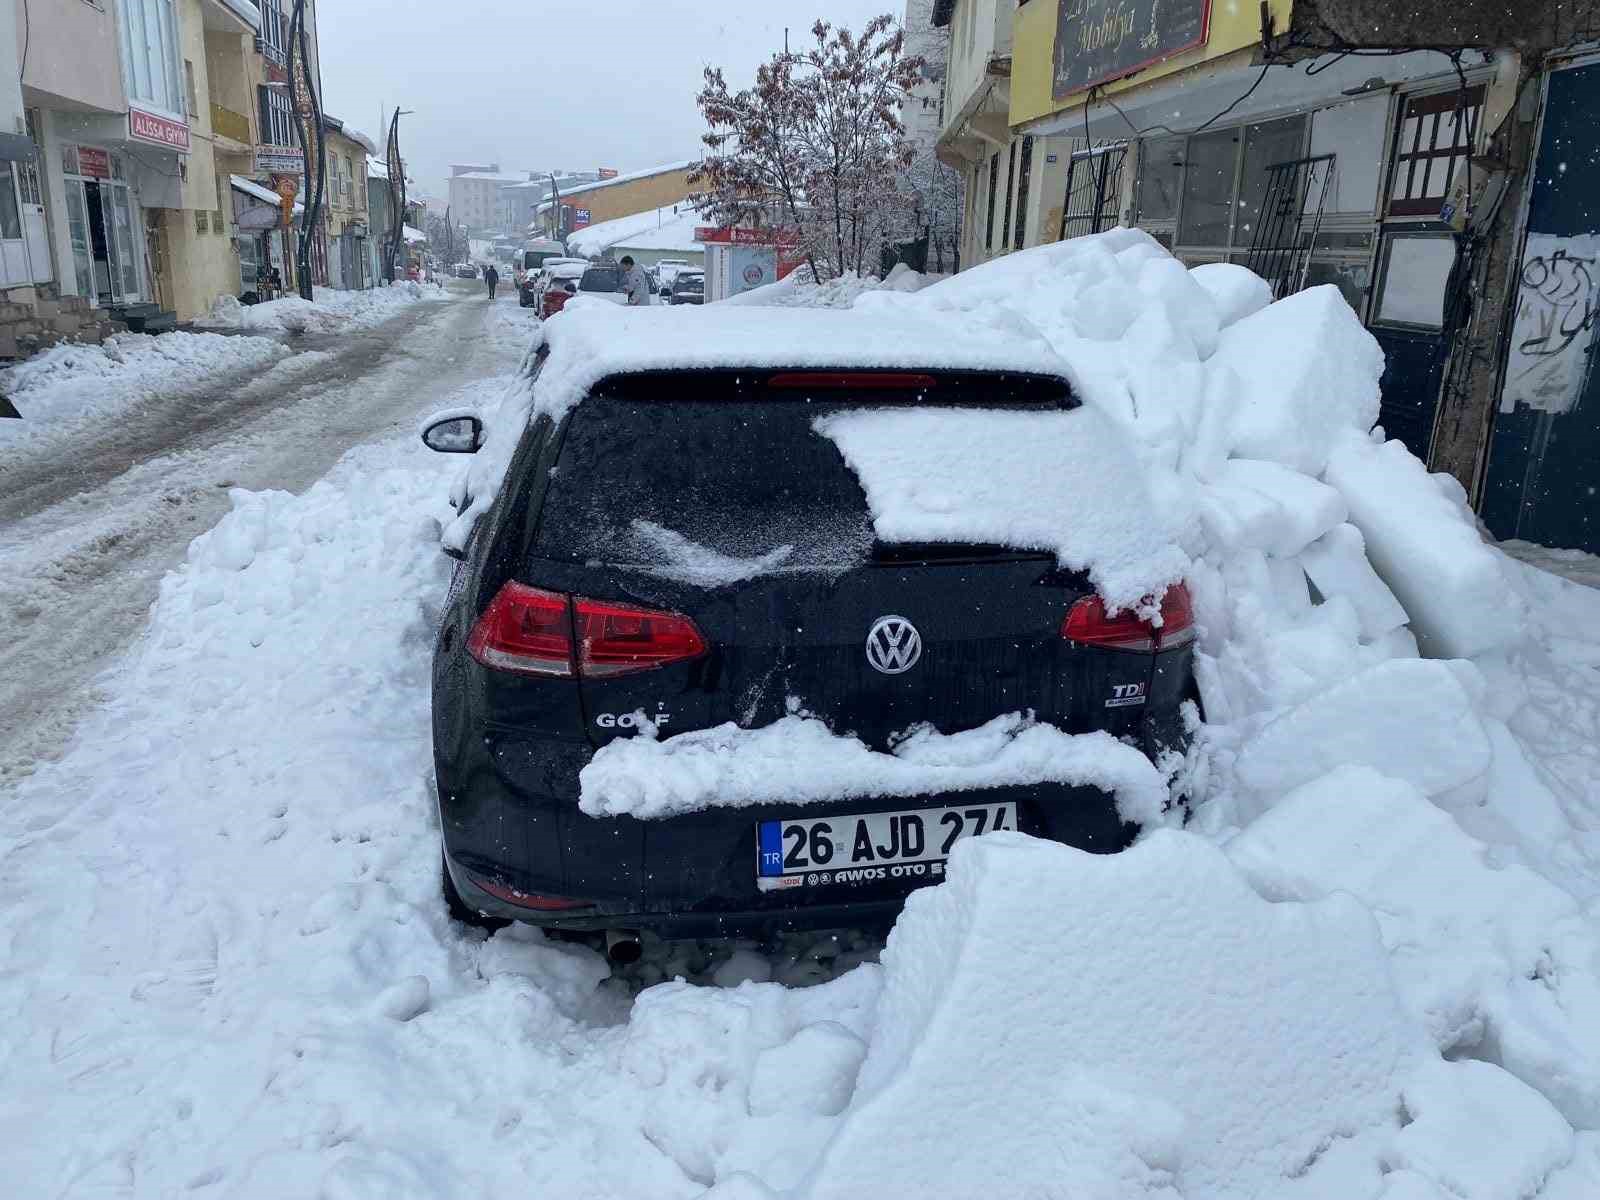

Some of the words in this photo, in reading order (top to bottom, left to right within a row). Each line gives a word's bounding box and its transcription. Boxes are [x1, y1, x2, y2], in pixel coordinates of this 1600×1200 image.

[596, 712, 670, 728] GOF
[783, 822, 834, 868] 26
[852, 815, 925, 862] AJD
[763, 852, 780, 866] TR
[835, 866, 886, 884] AWOS
[891, 863, 926, 877] OTO
